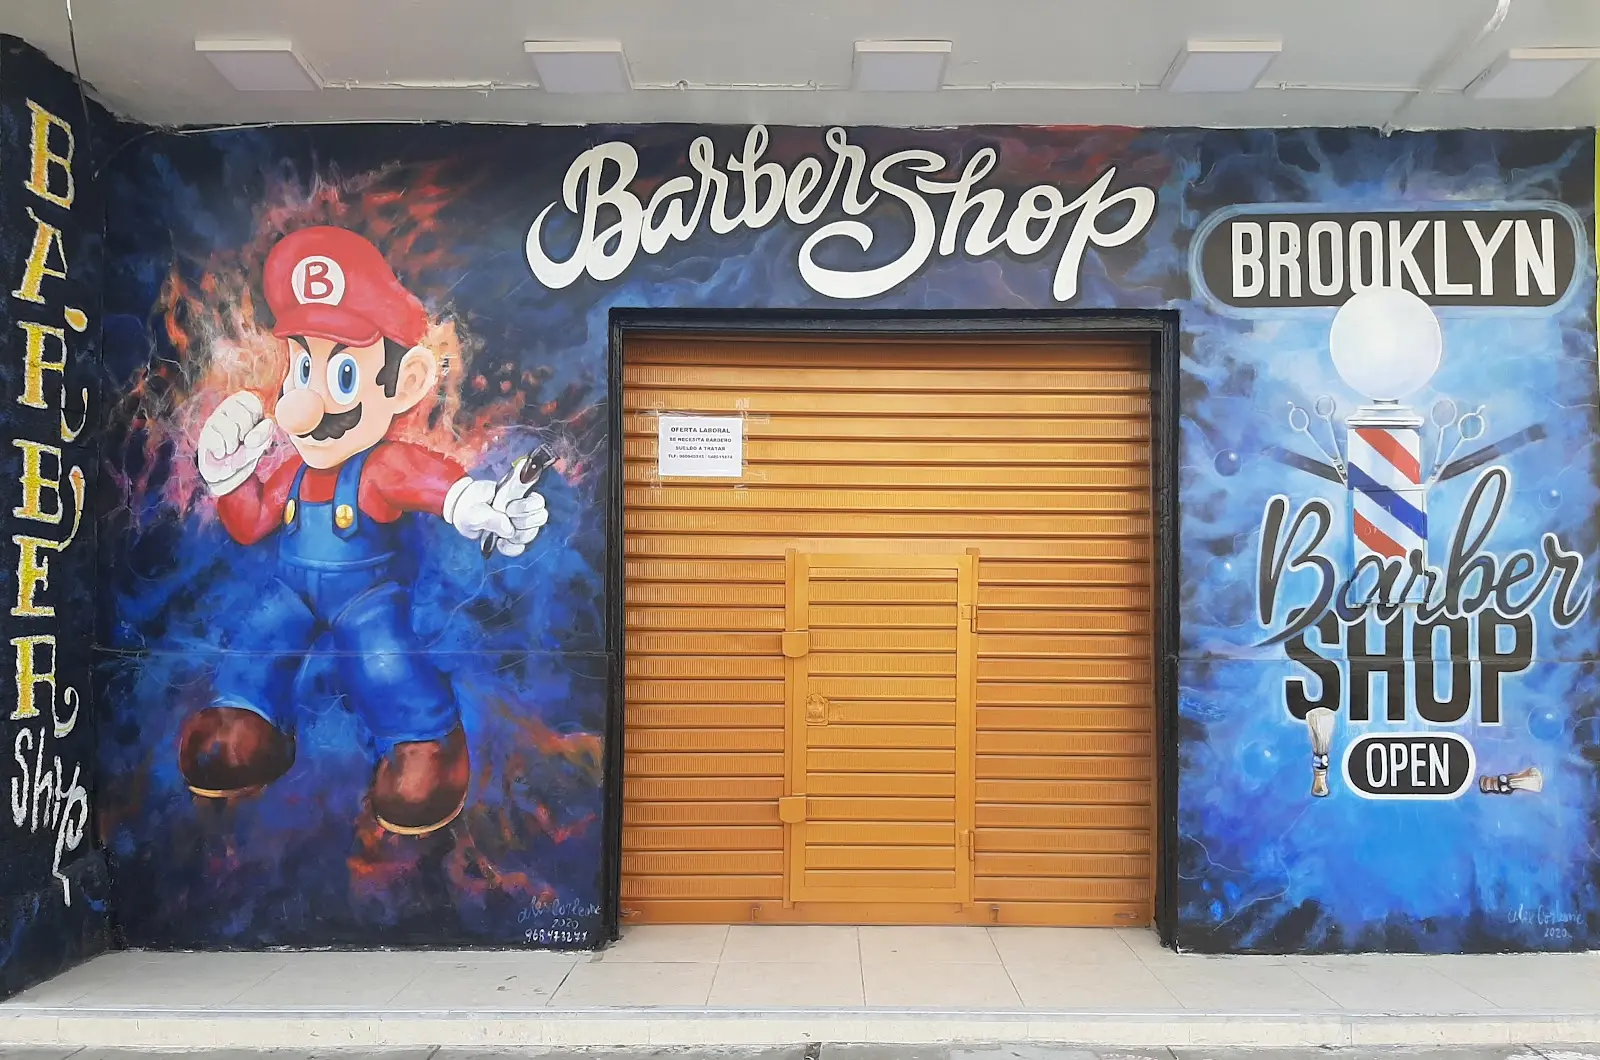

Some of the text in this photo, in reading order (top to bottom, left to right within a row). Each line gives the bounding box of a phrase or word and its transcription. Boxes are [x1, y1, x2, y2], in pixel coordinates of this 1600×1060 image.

[303, 261, 334, 299] B
[1231, 218, 1556, 298] BROOKLYN
[10, 97, 89, 738] BARBER
[1251, 467, 1588, 648] Barber
[1284, 607, 1534, 724] SHOP
[1366, 743, 1450, 788] OPEN
